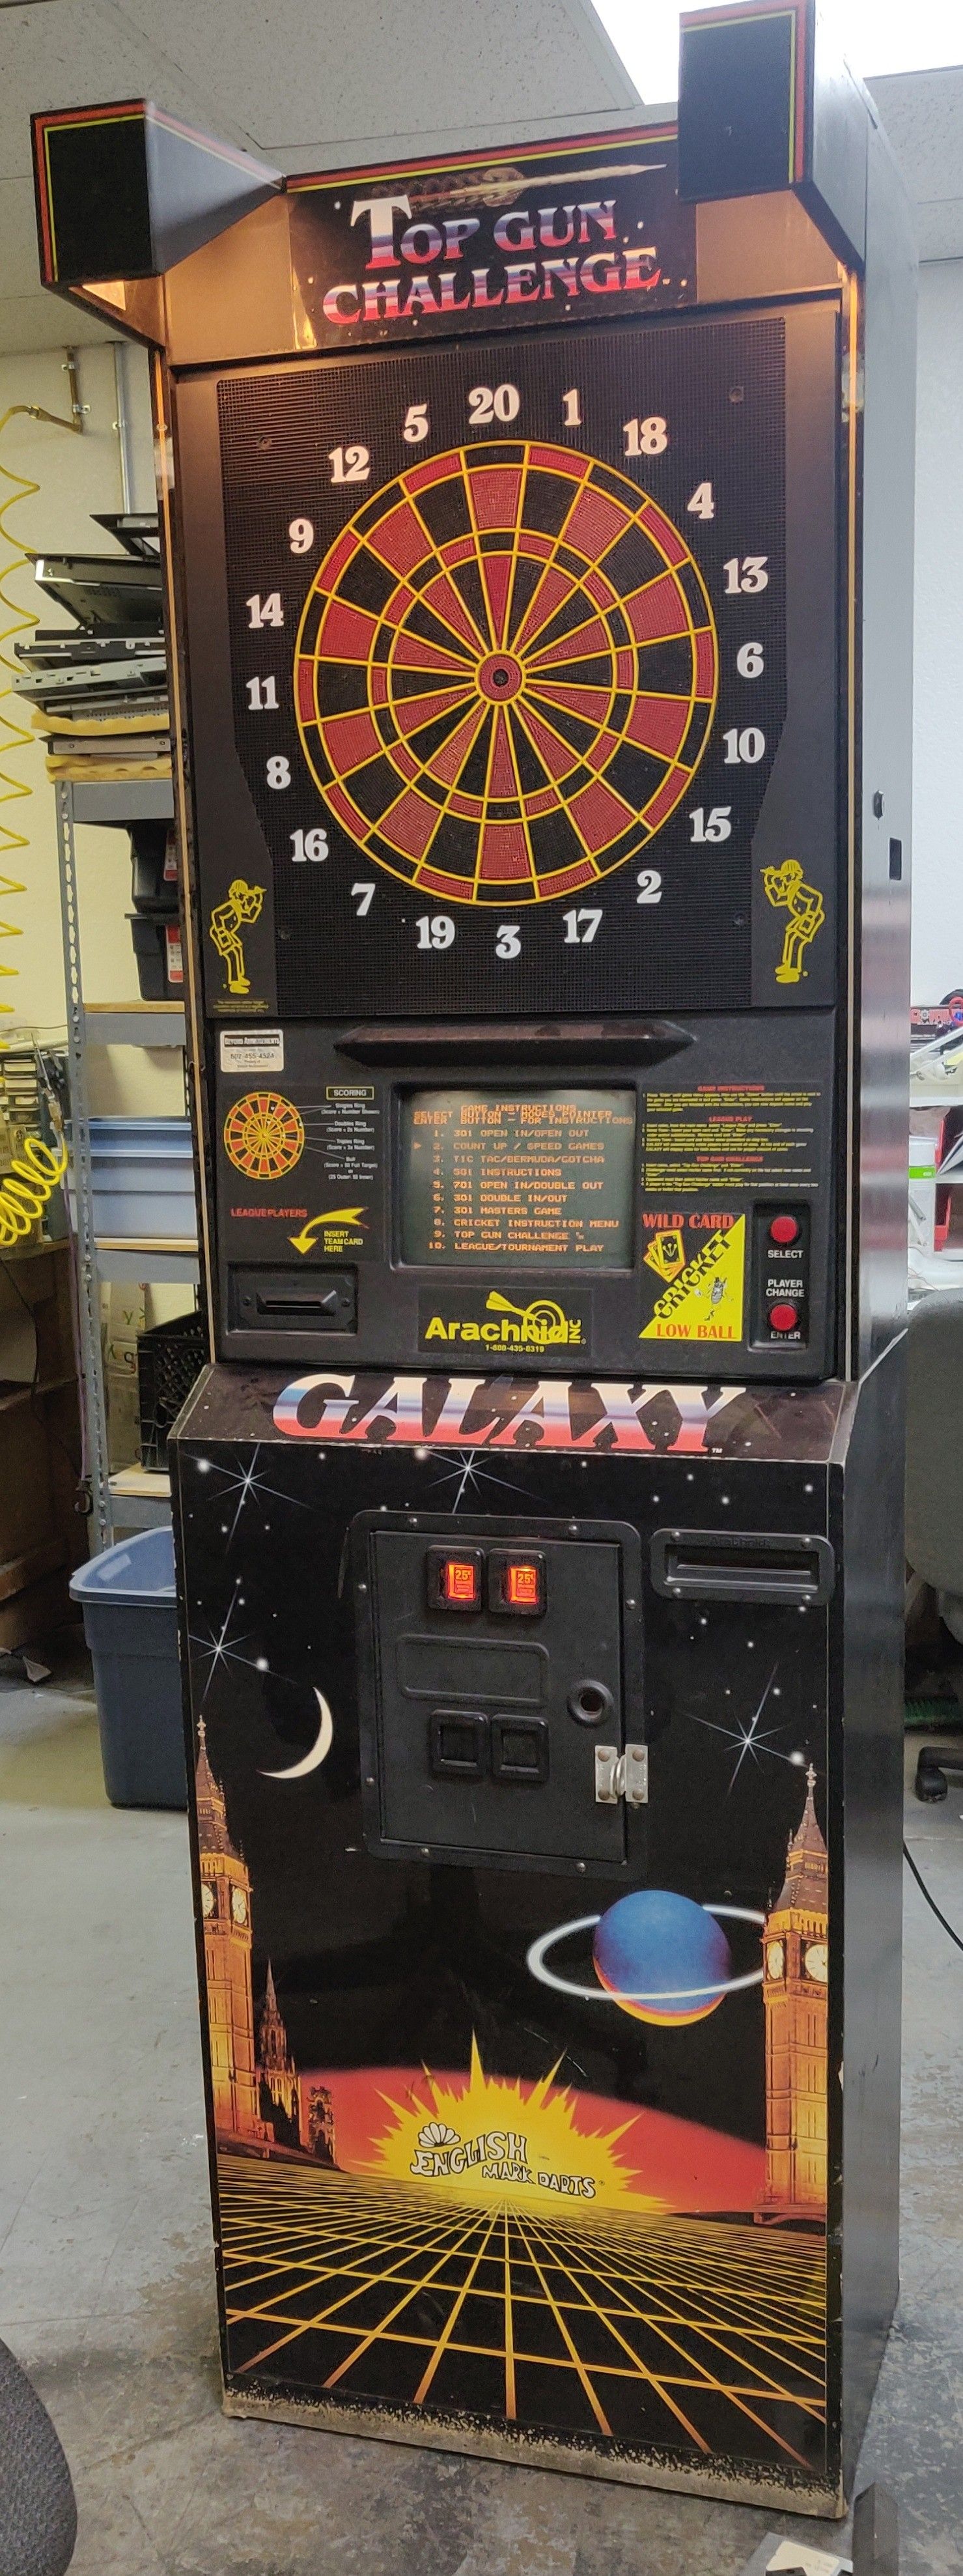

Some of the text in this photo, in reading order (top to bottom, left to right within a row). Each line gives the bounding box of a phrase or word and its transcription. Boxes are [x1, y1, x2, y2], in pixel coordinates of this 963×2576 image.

[350, 195, 617, 271] TOP GUN
[323, 247, 661, 324] CHALLENGE
[468, 384, 520, 424] 20
[563, 388, 583, 427] 1
[403, 403, 428, 443] 5
[622, 416, 667, 456] 18
[328, 446, 370, 483] 12
[687, 482, 714, 519] 4
[288, 518, 314, 554] 9
[723, 556, 769, 594] 13
[246, 593, 284, 629] 14
[736, 642, 764, 678] 6
[246, 676, 279, 710] 11
[722, 727, 765, 764] 10
[266, 756, 291, 789] 8
[689, 806, 732, 842] 15
[290, 828, 329, 862] 16
[351, 883, 376, 916] 7
[636, 870, 662, 904] 2
[415, 915, 455, 949] 19
[495, 925, 521, 959] 3
[562, 909, 603, 943] 17
[480, 1181, 508, 1189] OPEN
[514, 1182, 575, 1190] IN/DOUBLE
[582, 1182, 604, 1190] OUT
[481, 1168, 562, 1177] INSTRUCTIONS
[230, 1208, 307, 1217] LEAGUE PLAYERS
[453, 1194, 473, 1202] 301
[480, 1194, 522, 1202] DOUBLE
[527, 1195, 568, 1203] IN/OUT
[453, 1206, 473, 1215] 301
[480, 1207, 528, 1215] MASTERS
[453, 1219, 501, 1227] CRICKET
[508, 1219, 583, 1228] INSTRUCTION
[589, 1220, 619, 1228] MENU
[507, 1232, 569, 1240] CHALLENGE
[642, 1213, 735, 1229] WILD CARD
[454, 1242, 568, 1252] LEAGUE/TOURNAMENT
[768, 1250, 803, 1258] SELECT
[654, 1230, 731, 1319] CRICKET
[768, 1279, 803, 1288] PLAYER
[766, 1288, 805, 1297] CHANGE
[425, 1316, 581, 1344] Arachnid INC
[656, 1323, 736, 1339] LOW BALL
[273, 1373, 746, 1452] GALAXY
[410, 2131, 528, 2177] ENGLISH
[482, 2162, 596, 2198] MARK DARTS
